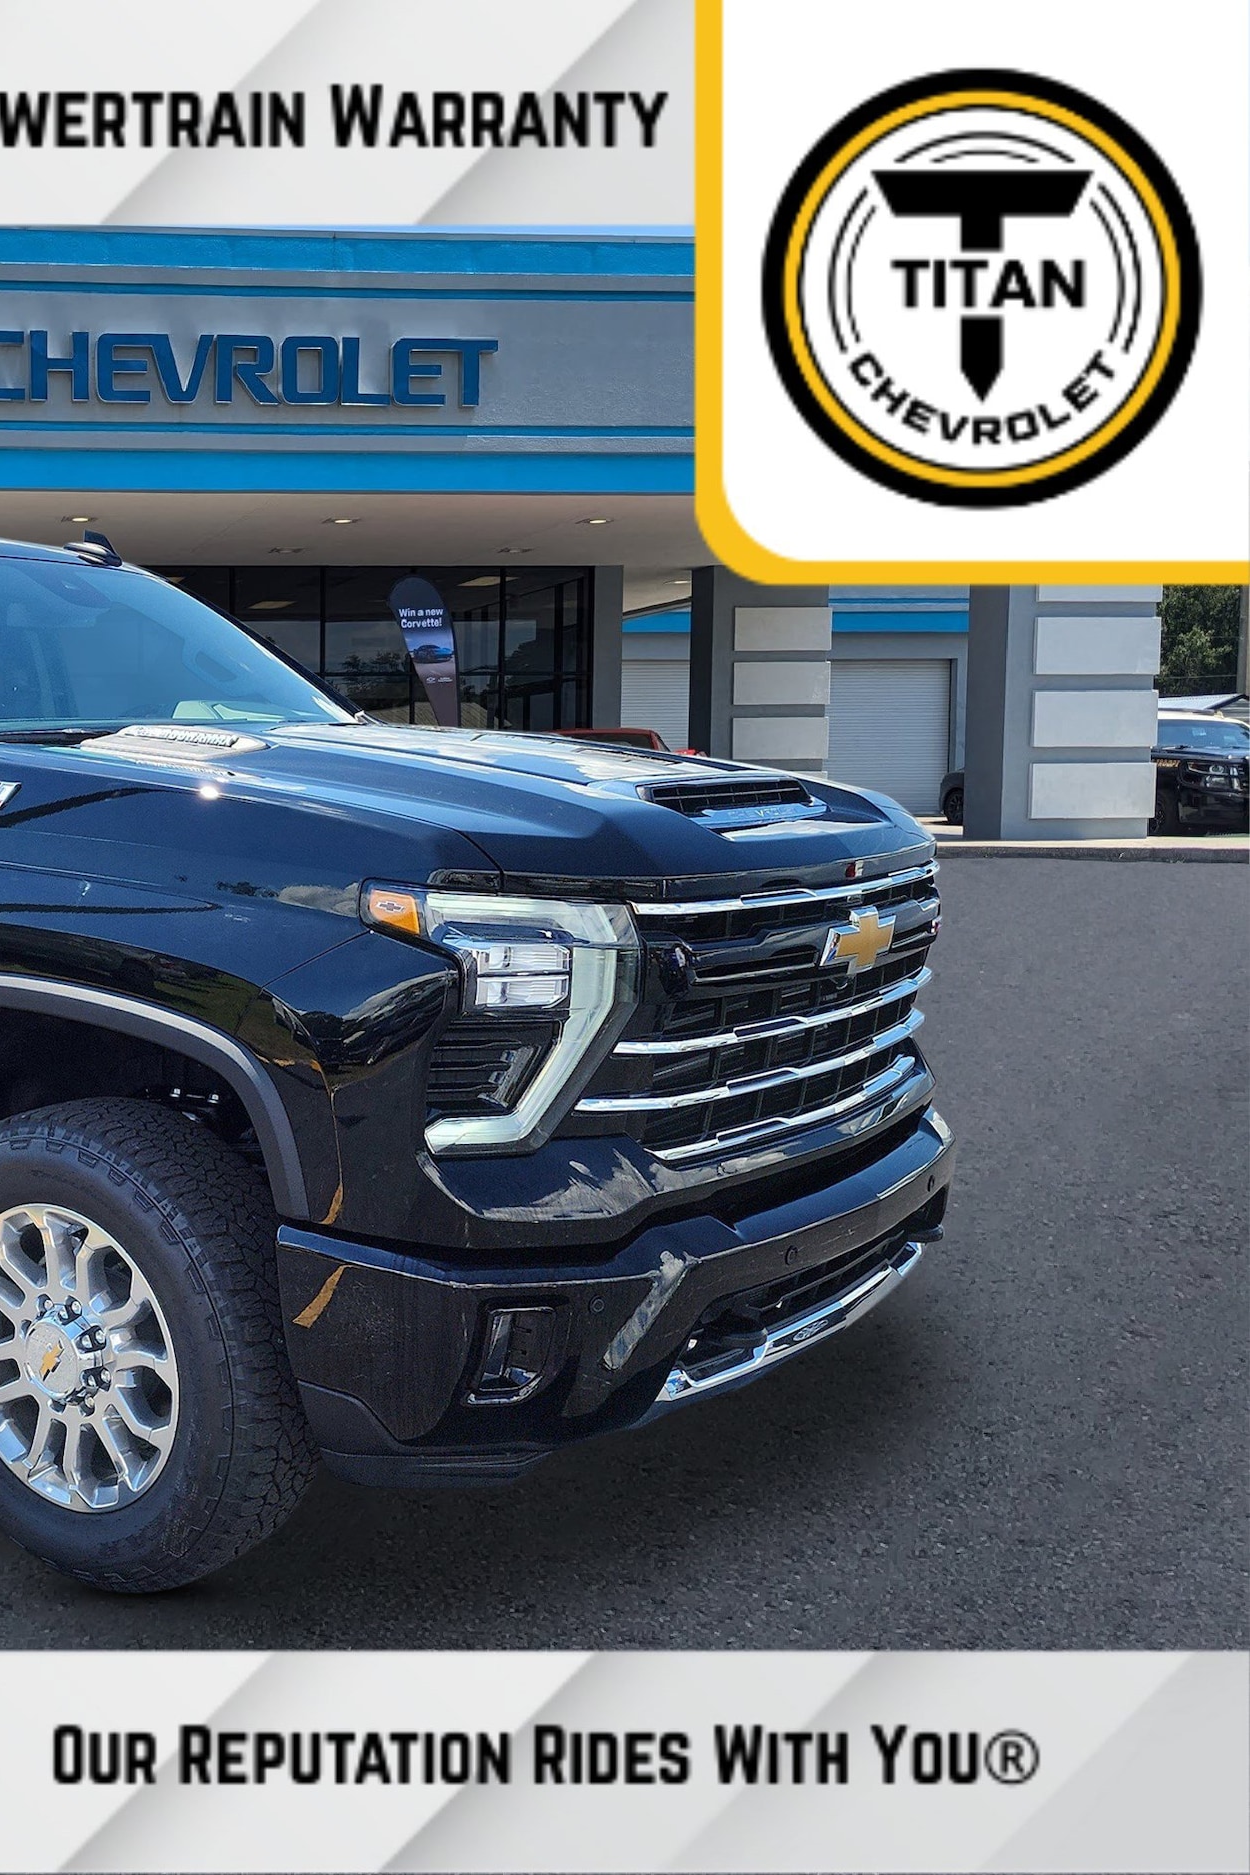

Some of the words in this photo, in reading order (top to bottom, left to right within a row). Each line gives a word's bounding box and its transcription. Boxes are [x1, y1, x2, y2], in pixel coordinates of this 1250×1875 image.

[398, 607, 416, 617] Win
[417, 609, 424, 617] a
[425, 608, 444, 617] new
[401, 617, 443, 628] Corvette!
